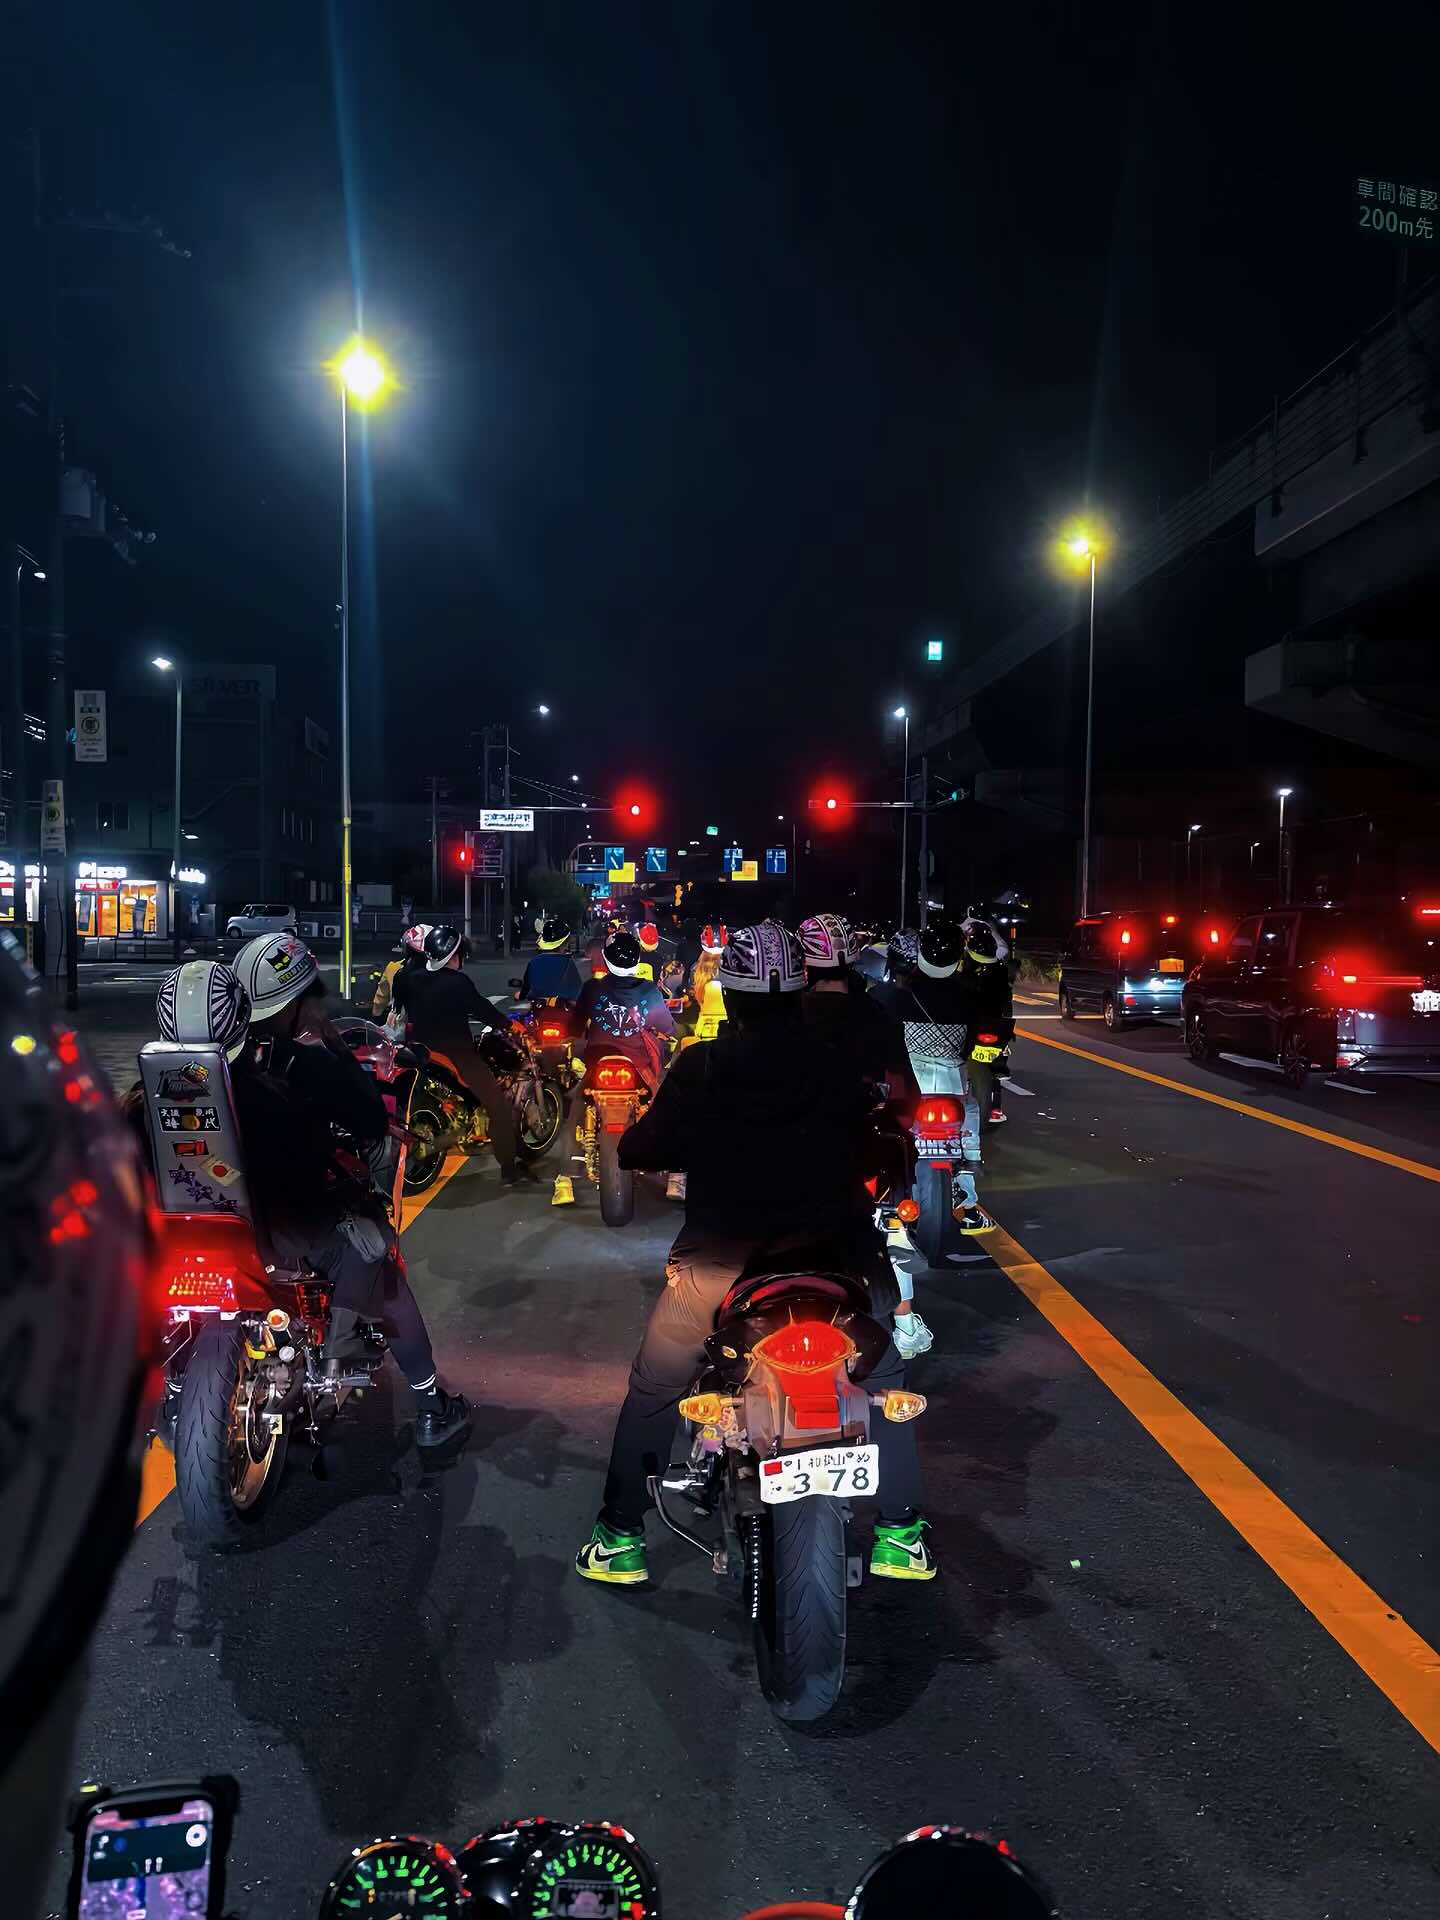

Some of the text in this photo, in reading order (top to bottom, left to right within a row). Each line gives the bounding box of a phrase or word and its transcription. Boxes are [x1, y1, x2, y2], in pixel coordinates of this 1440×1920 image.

[1357, 178, 1440, 211] 車間確認
[1359, 205, 1433, 239] 200m先
